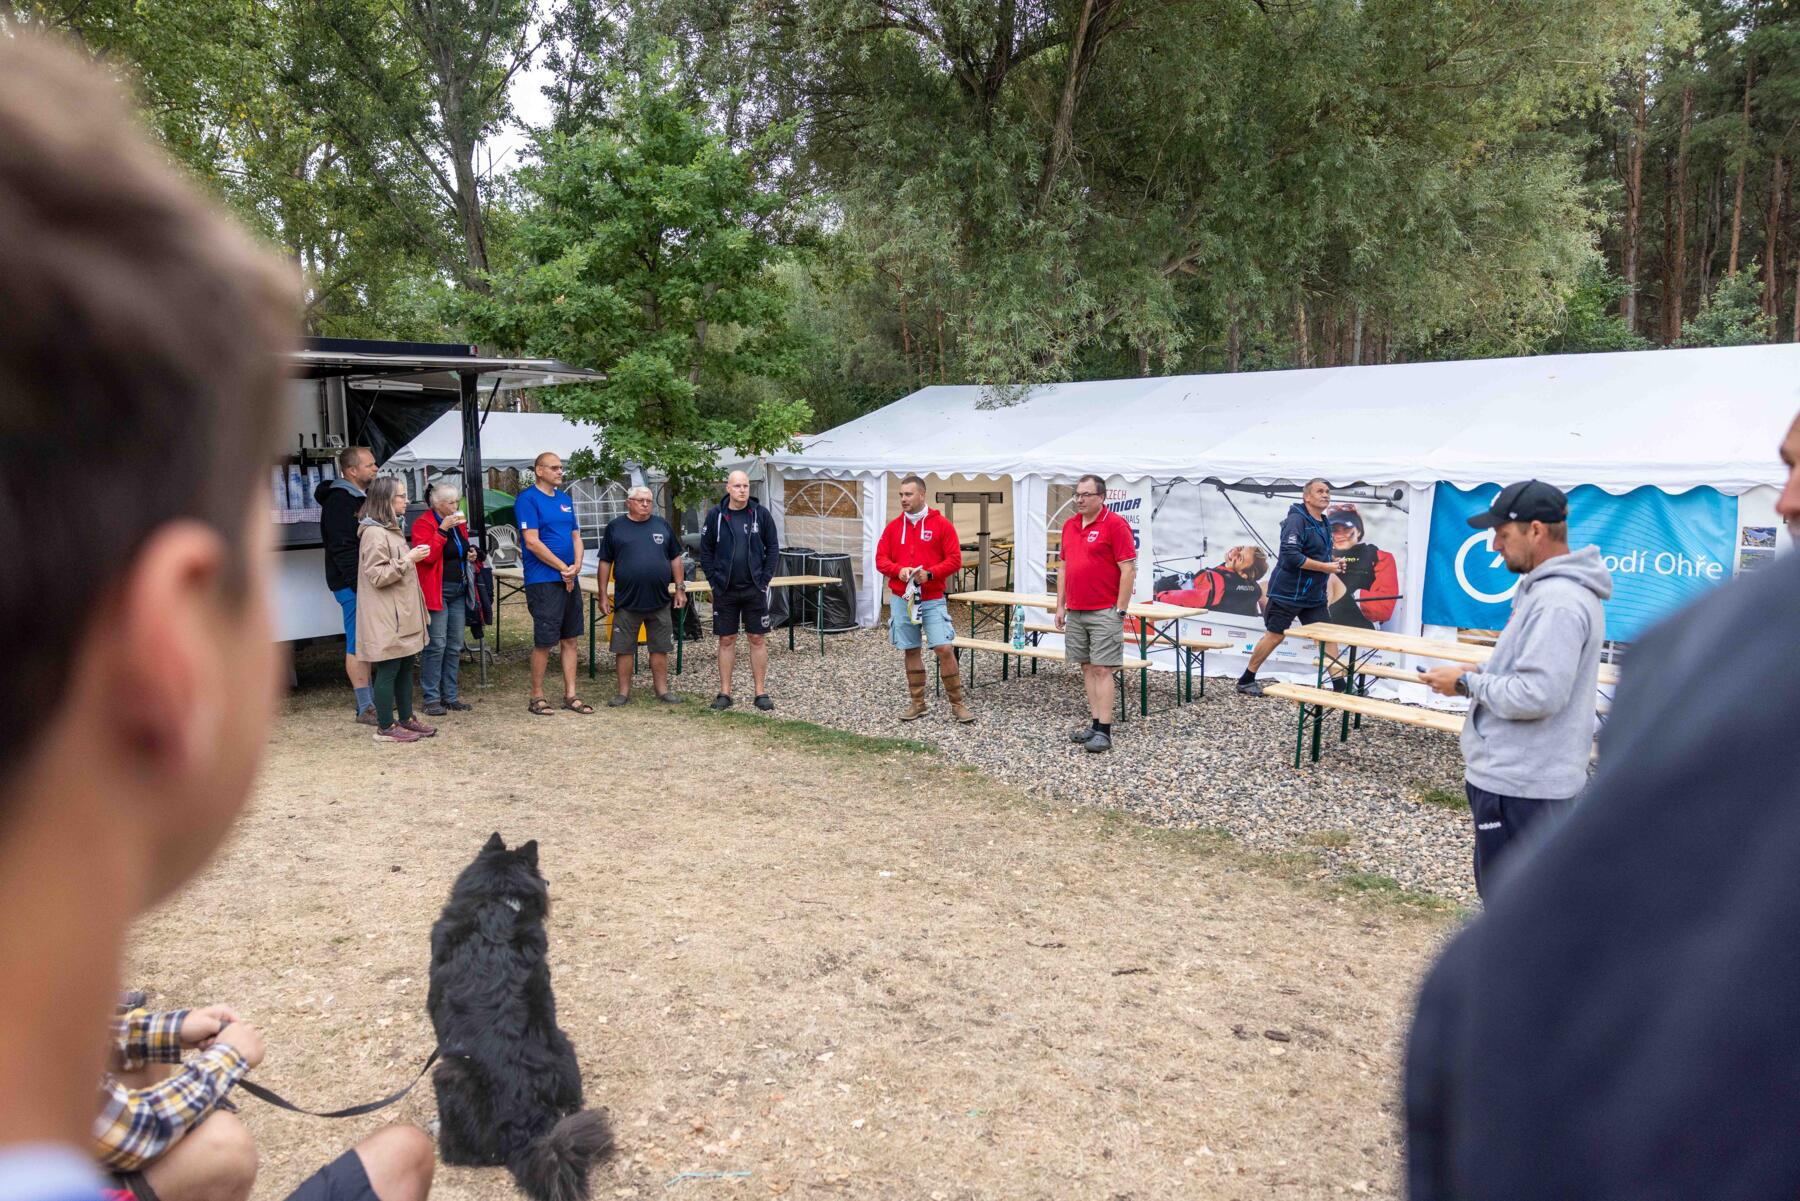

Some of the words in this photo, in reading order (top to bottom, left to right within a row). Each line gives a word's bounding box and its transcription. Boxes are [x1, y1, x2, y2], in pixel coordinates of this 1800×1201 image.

[1106, 497, 1142, 513] UNIOR
[1132, 529, 1140, 550] 5
[1599, 550, 1648, 574] odí
[1654, 551, 1724, 580] Ohře
